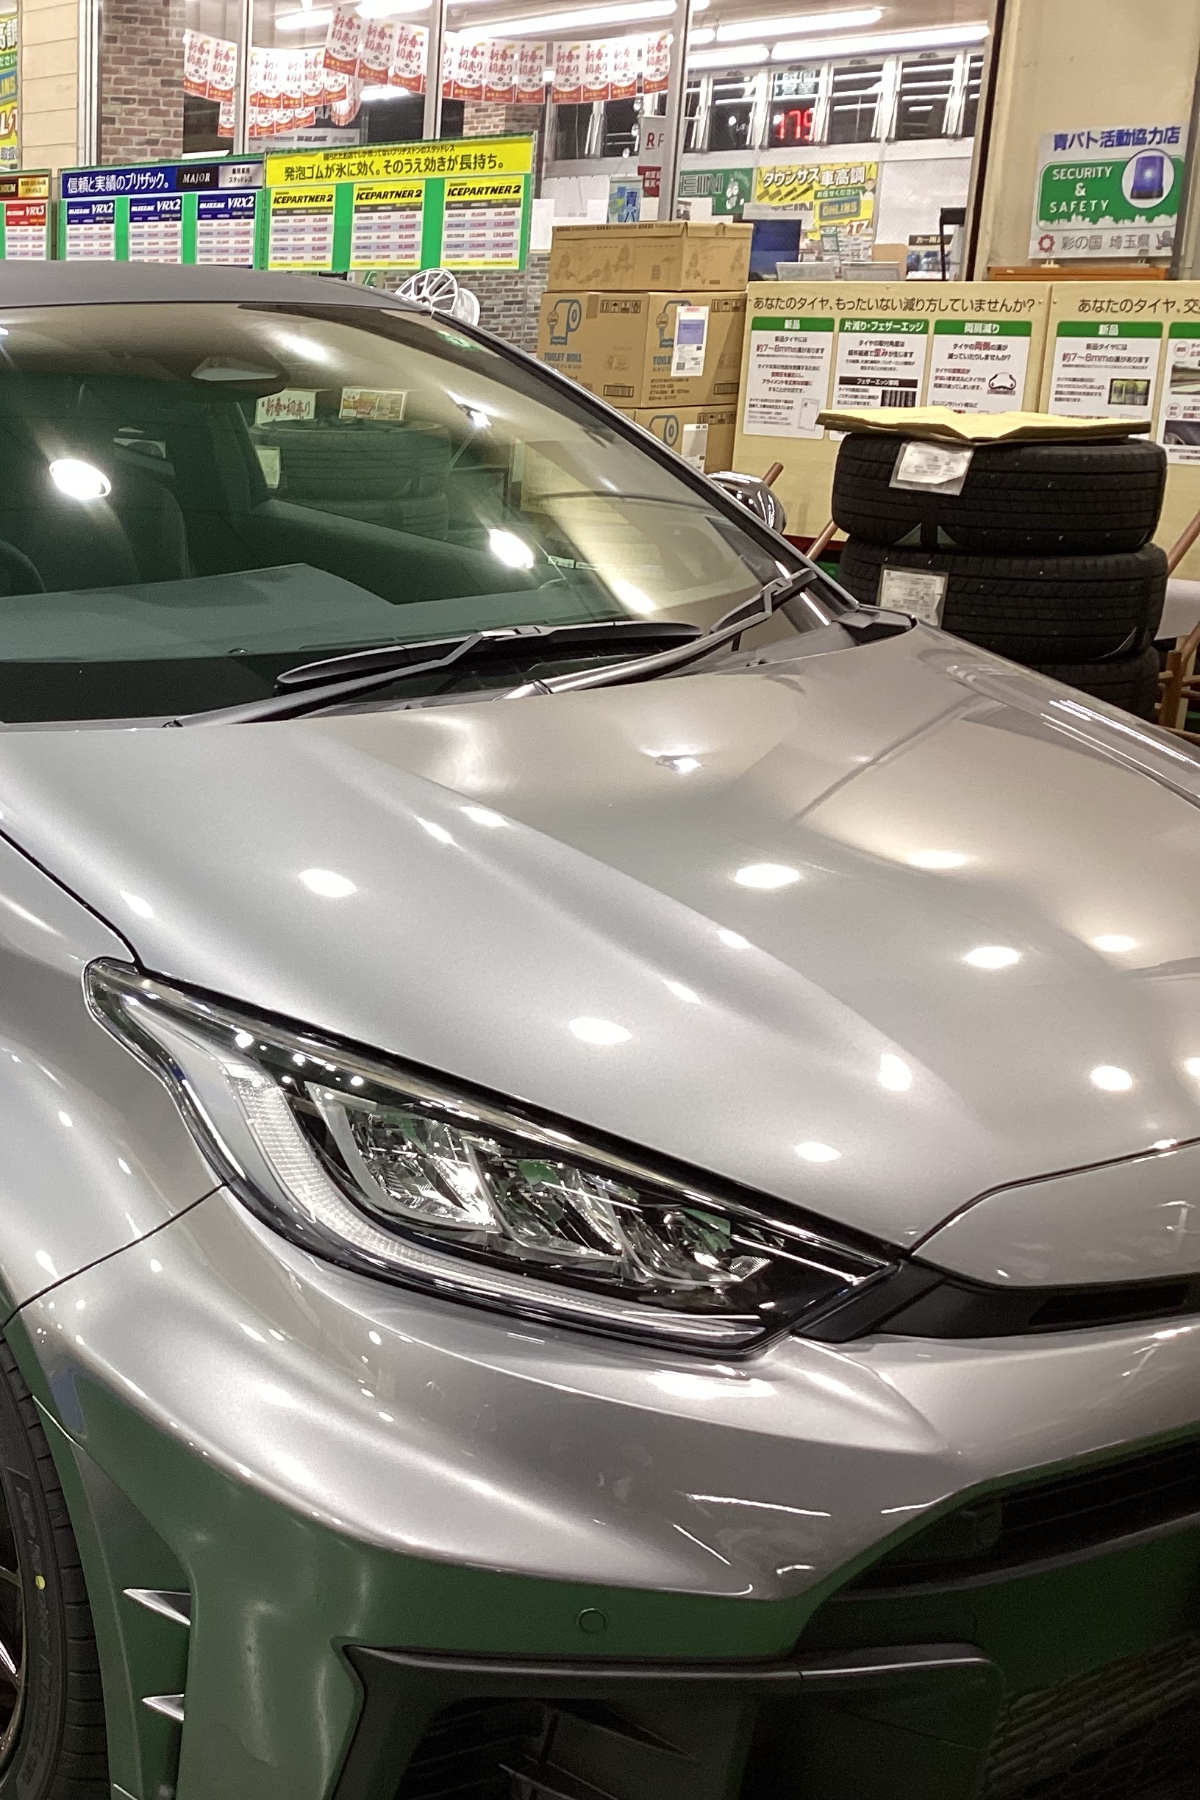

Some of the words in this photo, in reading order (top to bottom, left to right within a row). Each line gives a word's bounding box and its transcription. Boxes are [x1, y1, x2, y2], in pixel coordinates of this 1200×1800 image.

[1054, 126, 1181, 151] 青パト活動協力店
[284, 153, 504, 181] 発泡ゴムが氷に効く。そのうえ効きが長持ち。
[1052, 166, 1113, 180] SECURITY
[67, 172, 169, 194] 信頼と実績のブリザック。
[182, 172, 211, 184] MAJOR
[356, 190, 414, 200] ICEPARTNER
[415, 189, 422, 197] 2
[447, 186, 512, 196] ICEPARTNER
[513, 185, 521, 194] 2
[1075, 182, 1086, 196] &
[227, 196, 254, 208] VRX2
[273, 195, 325, 204] ICEPARTNER
[326, 194, 334, 202] 2
[91, 202, 113, 214] VRX2
[156, 199, 181, 212] VRX2
[1050, 200, 1109, 213] SAFETY
[1061, 235, 1102, 250] 彩の国
[1109, 234, 1150, 249] 埼玉県
[754, 296, 1034, 313] あなたのタイヤ、もったいない減り方していませんか?
[784, 319, 800, 330] 新品
[844, 320, 924, 332] 片減り・フェザーエッジ
[1099, 324, 1119, 336] 新品
